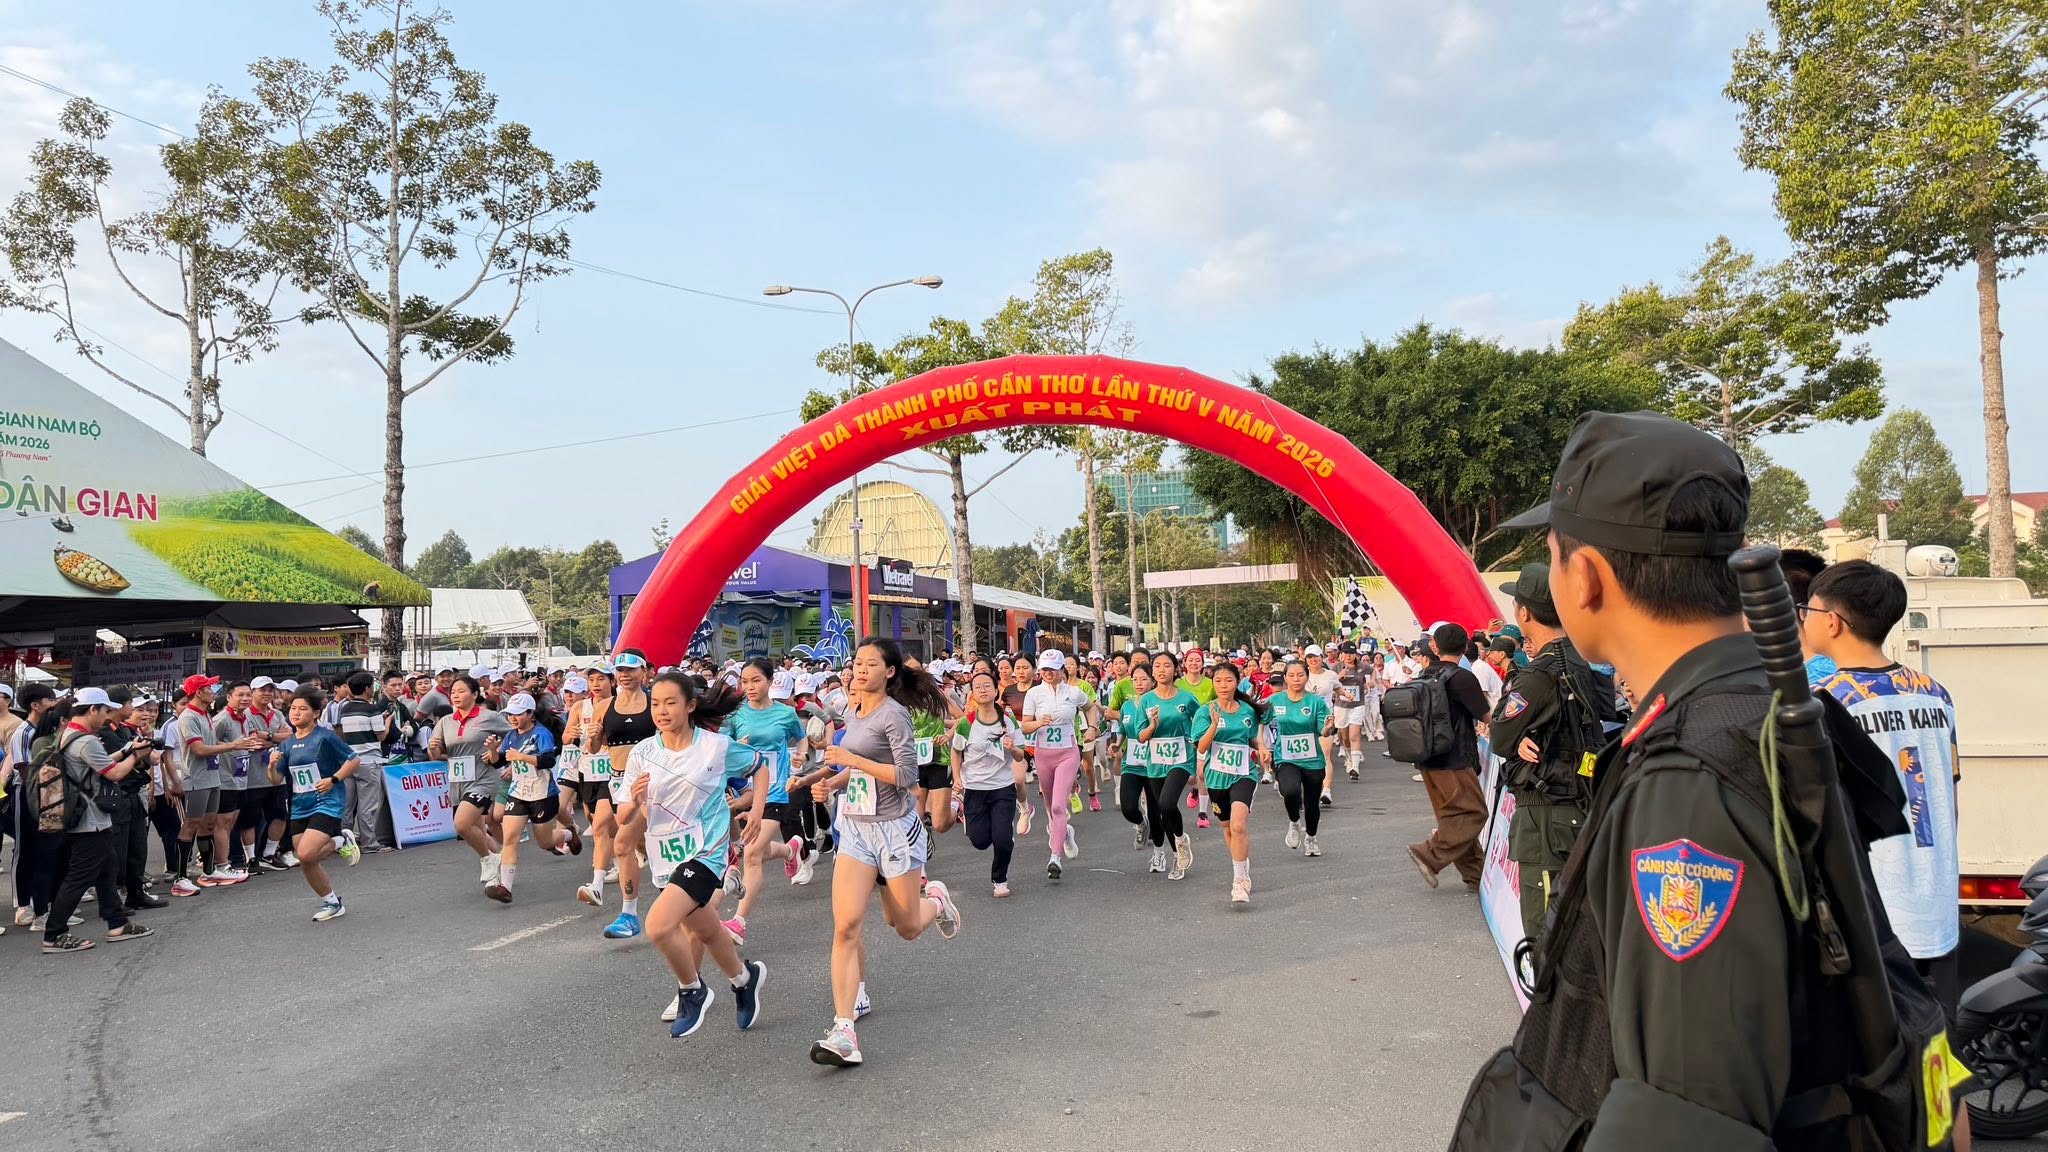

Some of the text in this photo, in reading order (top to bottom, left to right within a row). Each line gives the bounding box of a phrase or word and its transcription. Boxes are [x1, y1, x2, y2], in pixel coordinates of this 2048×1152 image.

[38, 416, 76, 434] NAM
[80, 420, 101, 440] BỘ
[899, 399, 1142, 440] XUẤT PHÁT
[20, 436, 50, 450] 2026
[730, 475, 773, 514] GIẢI
[771, 441, 817, 481] VIỆT
[820, 421, 852, 451] DÃ
[853, 393, 928, 434] THÀNH
[931, 376, 979, 408] PHỐ
[1039, 373, 1087, 395] THƠ
[1091, 373, 1140, 401] LẦN
[1148, 384, 1197, 411] THỨ
[1198, 397, 1216, 417] V
[1216, 404, 1276, 444] NĂM
[1276, 433, 1336, 478] 2026
[77, 488, 158, 521] GIAN
[730, 561, 757, 580] vel
[1909, 708, 1949, 729] KAHN
[1046, 727, 1062, 742] 23
[1133, 745, 1147, 760] 43
[1156, 742, 1180, 757] 432
[1287, 738, 1310, 754] 433
[1217, 747, 1243, 767] 430
[402, 769, 447, 791] GIẢI VIỆT
[659, 834, 697, 862] 454
[1637, 856, 1734, 882] CẢNH SÁT CƠ ĐỘNG
